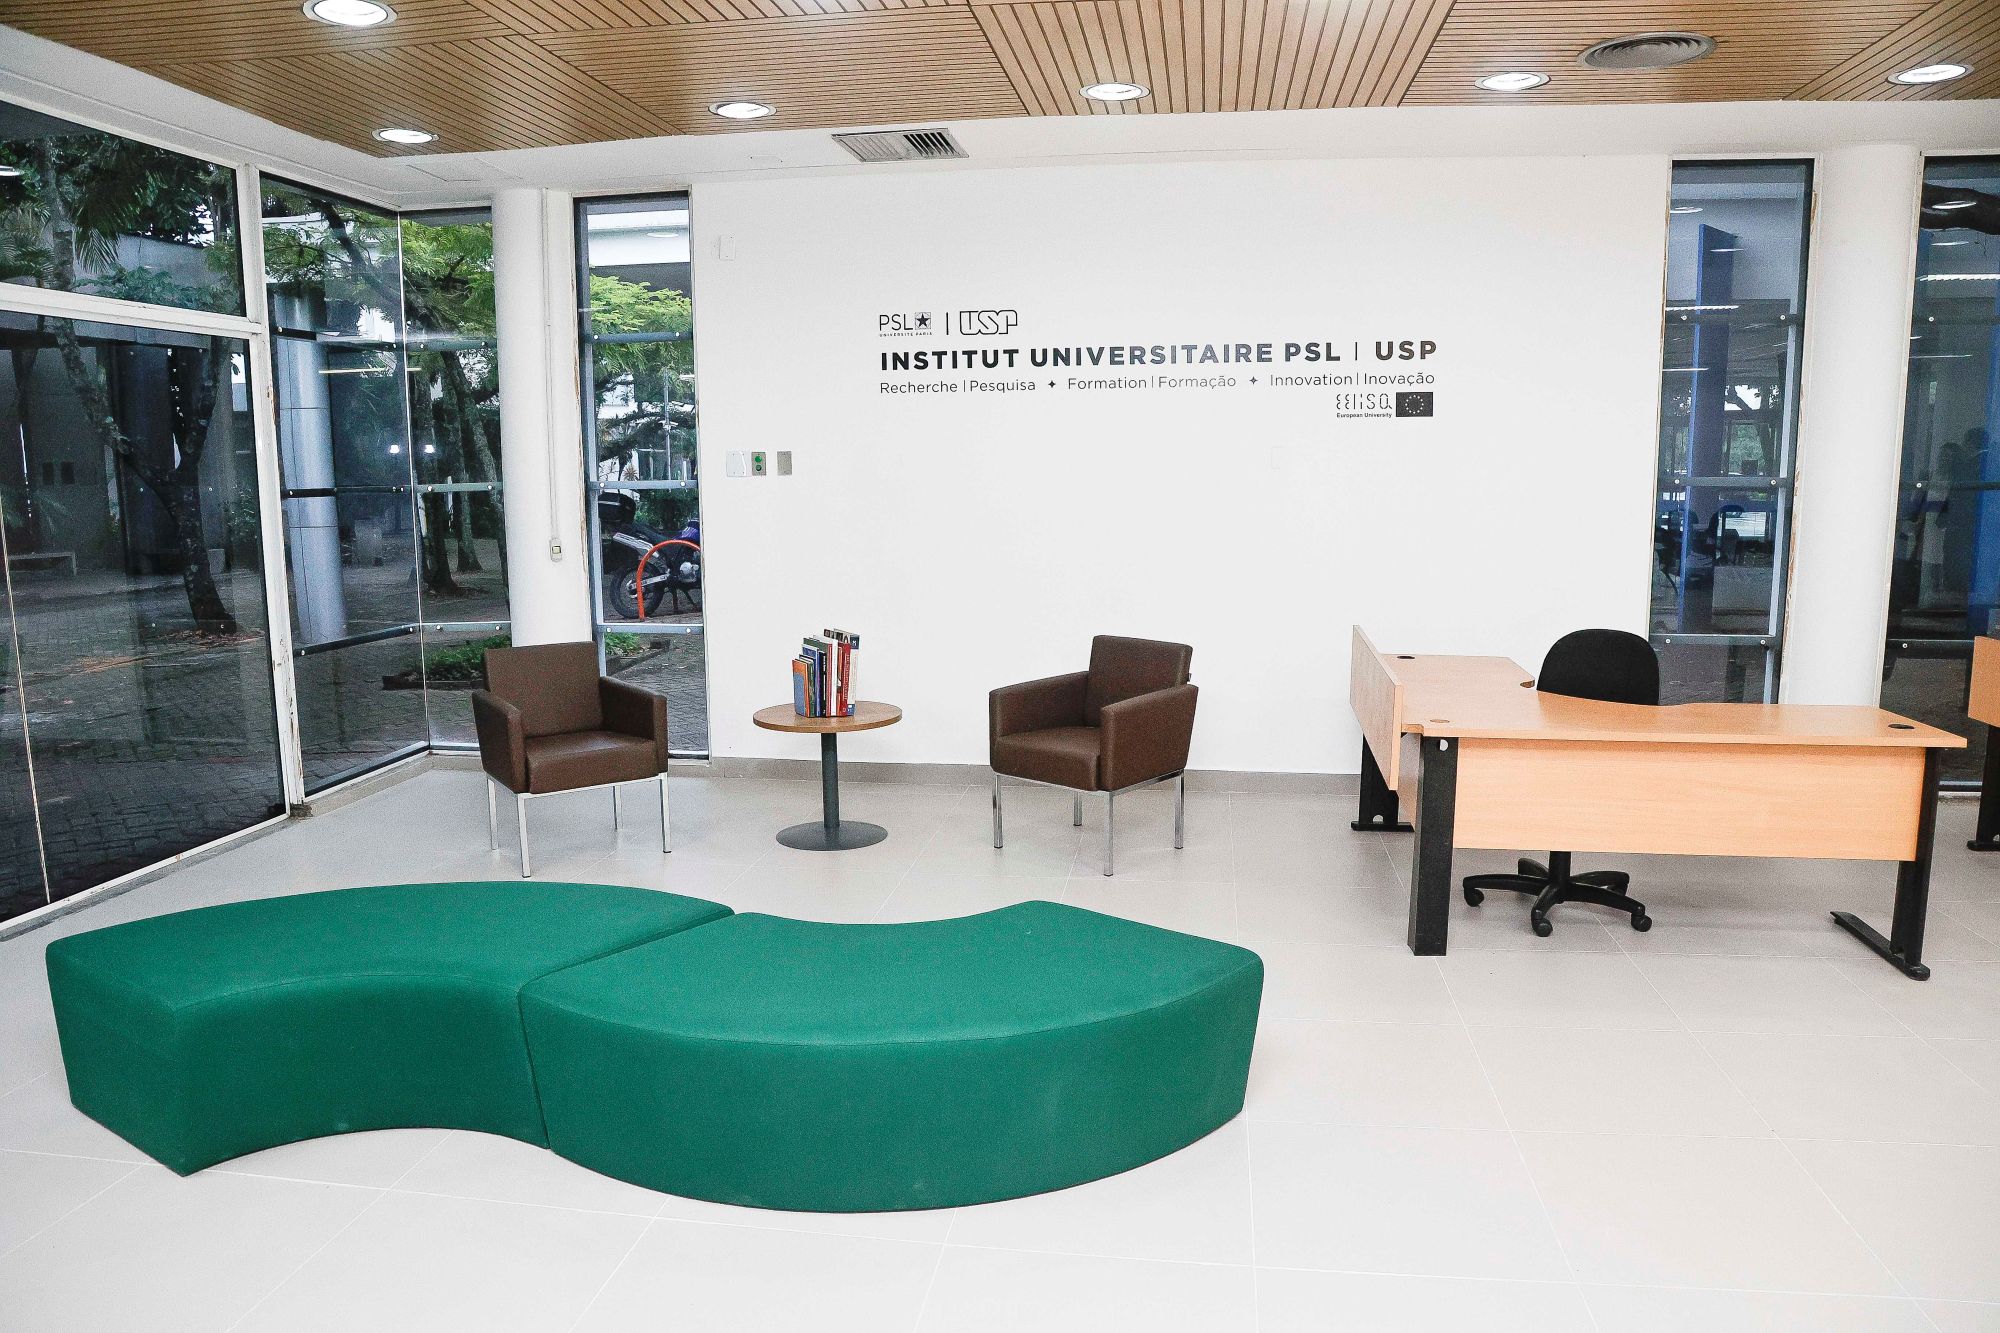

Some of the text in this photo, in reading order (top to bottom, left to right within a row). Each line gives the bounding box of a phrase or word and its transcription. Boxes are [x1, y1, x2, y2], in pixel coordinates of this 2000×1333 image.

[879, 309, 1019, 336] PSL USP
[881, 349, 1020, 371] INSTITUT
[1030, 344, 1273, 367] UNIVERSITAIRE
[1285, 342, 1341, 362] PSL
[1375, 340, 1437, 361] USP
[880, 380, 958, 394] Recherche
[969, 378, 1036, 394] Pesquisa
[1067, 376, 1147, 390] Formation
[1158, 375, 1237, 391] Formação
[1270, 373, 1353, 387] Innovation
[1364, 371, 1435, 387] Inovação
